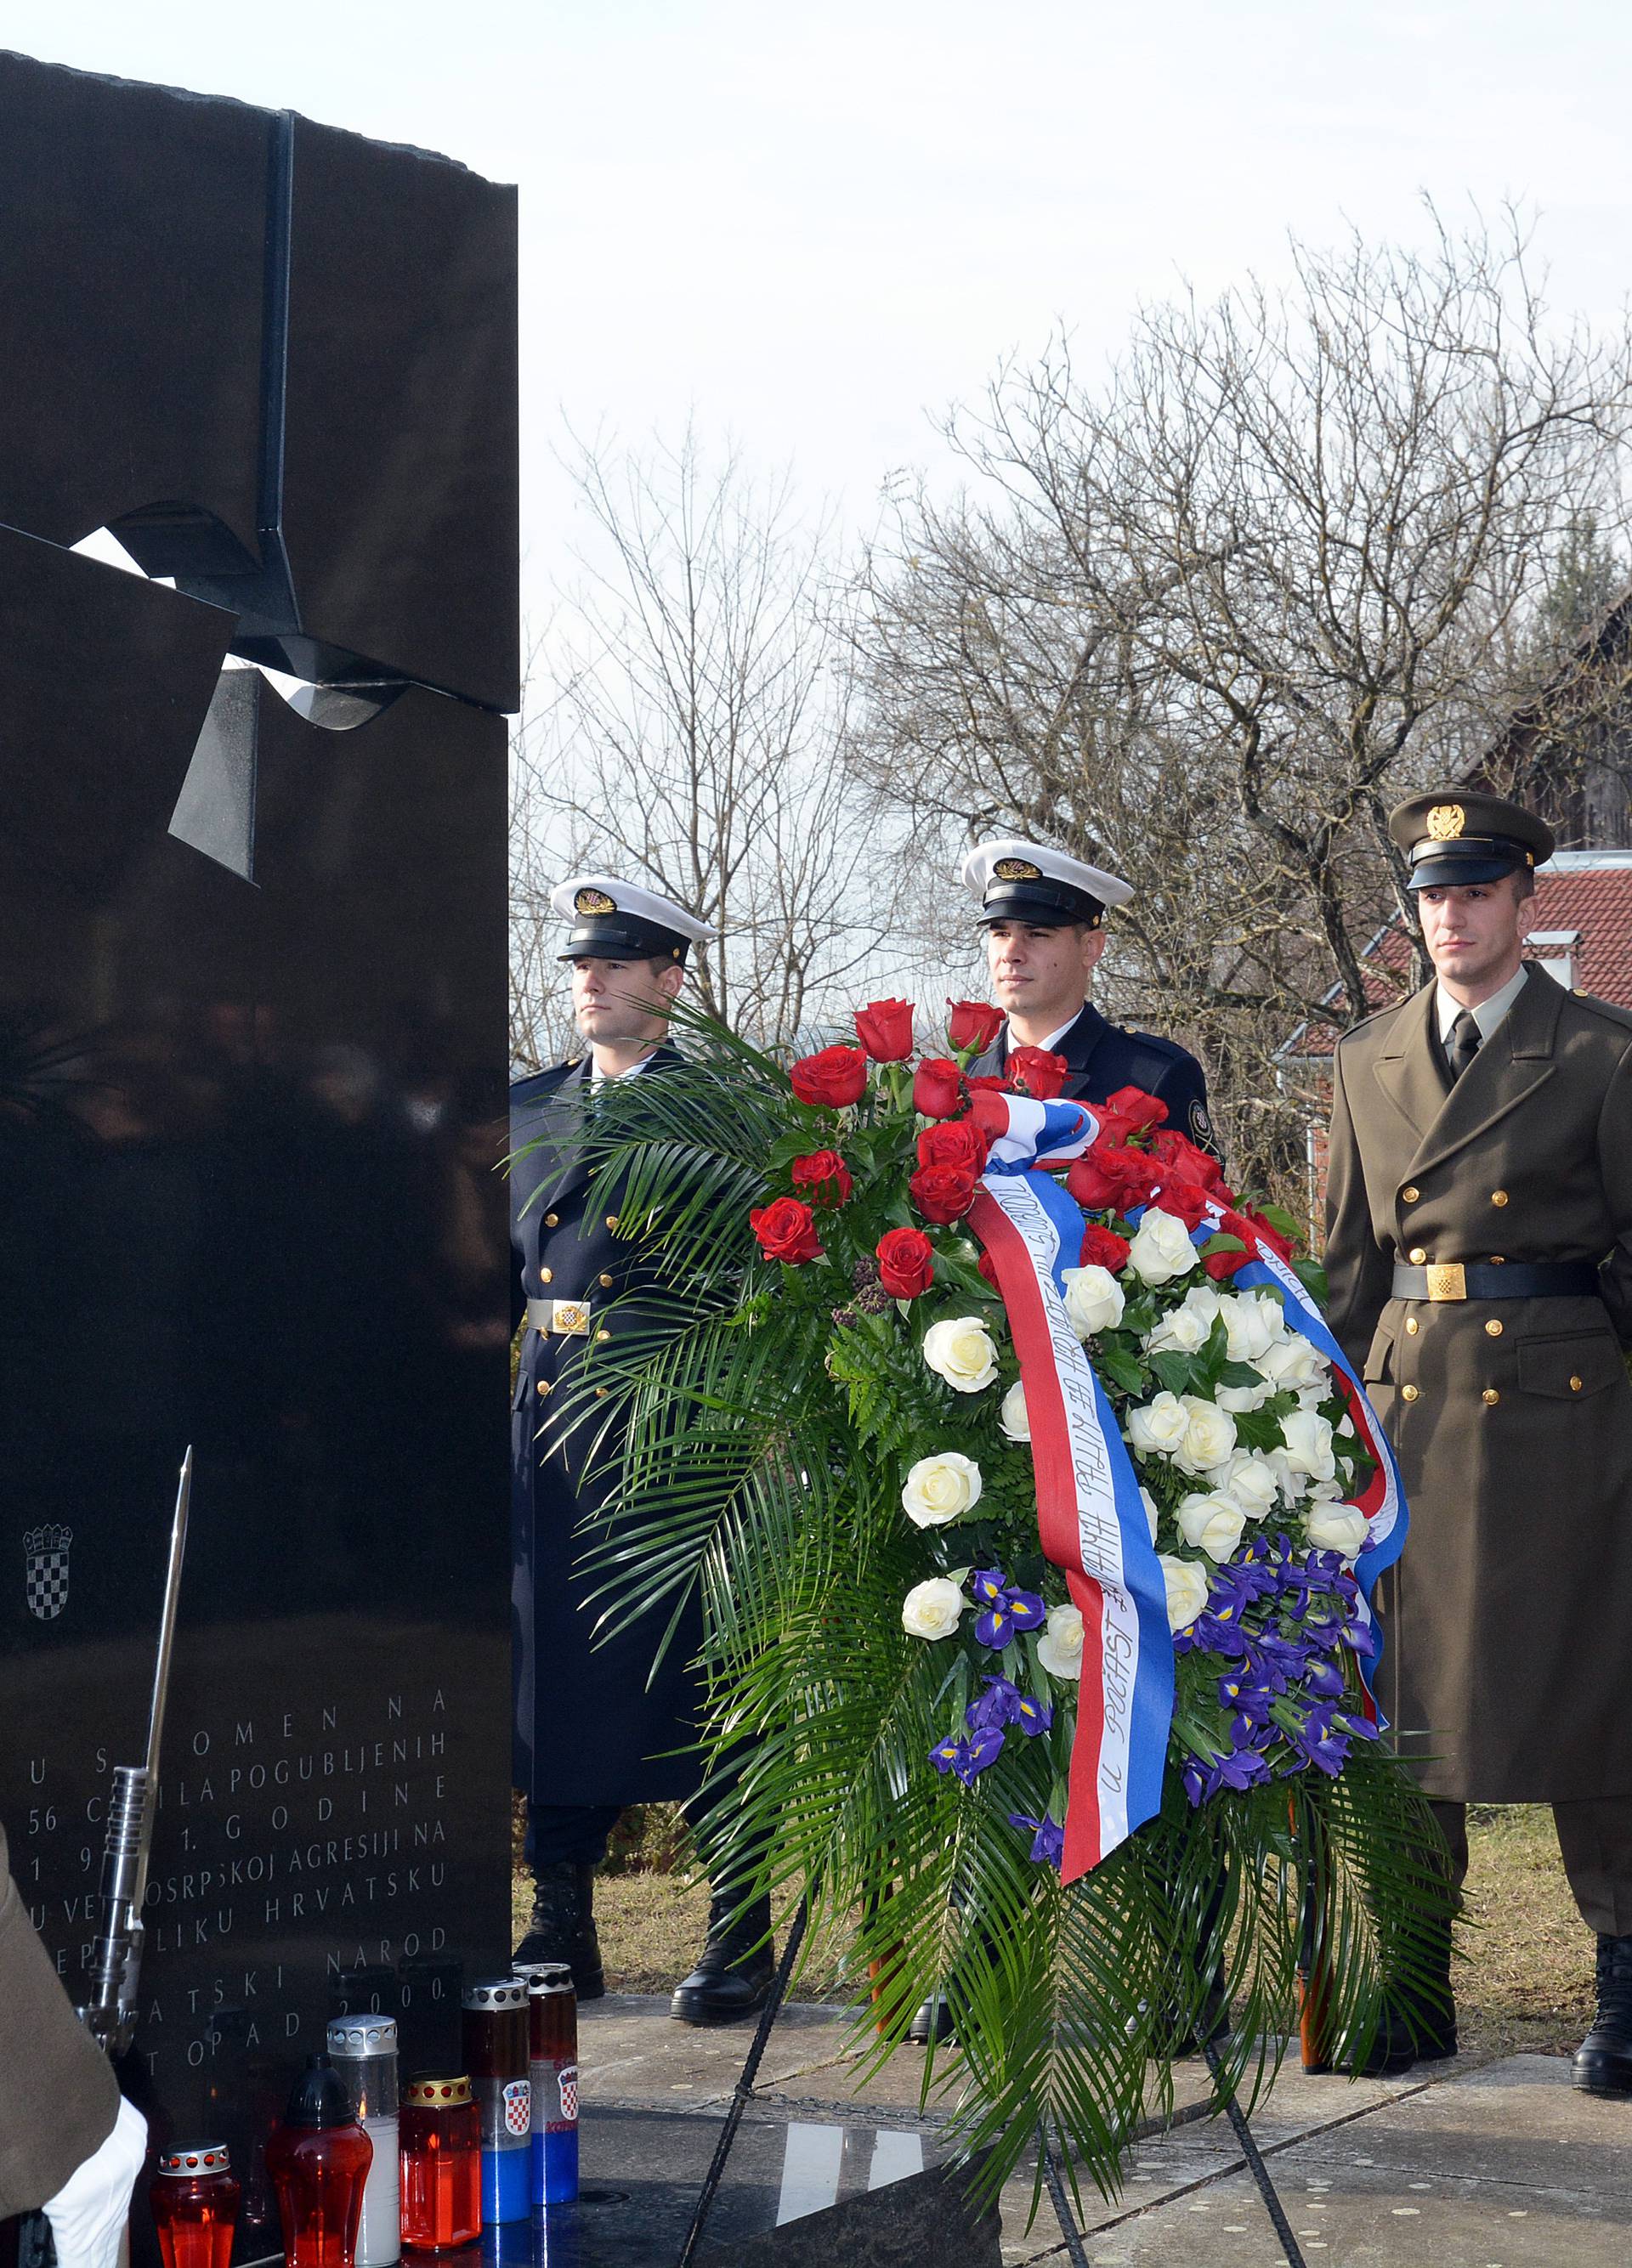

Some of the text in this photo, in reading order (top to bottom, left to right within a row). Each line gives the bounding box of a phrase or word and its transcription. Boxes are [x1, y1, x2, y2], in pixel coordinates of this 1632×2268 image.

[1062, 1376, 1096, 1418] ZA
[1102, 1609, 1134, 1745] POČAST
[27, 1732, 446, 1835] 56 CILA POGUBLJENIH
[30, 1688, 446, 1784] U SOMEN NA
[1100, 1762, 1123, 1794] U
[30, 1903, 46, 1931] U
[288, 1827, 400, 1876] AGRESIJI
[413, 1818, 446, 1845] NA
[31, 1774, 446, 1881] 191. GODINE
[56, 1863, 446, 1976] EPLIKU HRVATSKU
[147, 1926, 446, 2024] ATSKI NAROD
